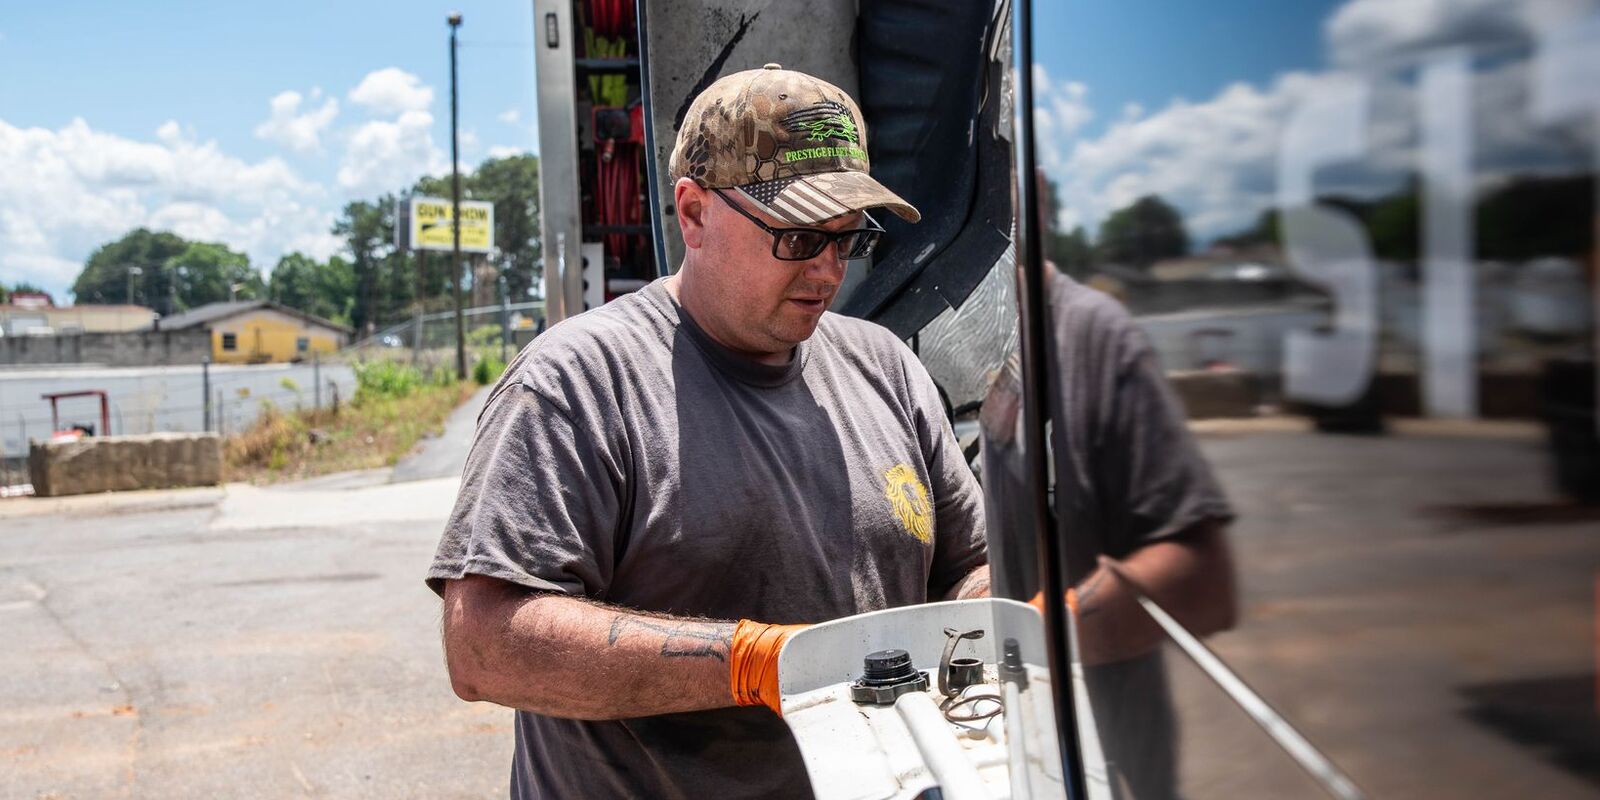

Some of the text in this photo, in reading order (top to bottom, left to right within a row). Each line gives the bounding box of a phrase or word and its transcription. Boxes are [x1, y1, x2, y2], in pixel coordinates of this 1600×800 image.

[785, 147, 828, 162] PRESTIGE
[417, 204, 488, 219] GUN HOW
